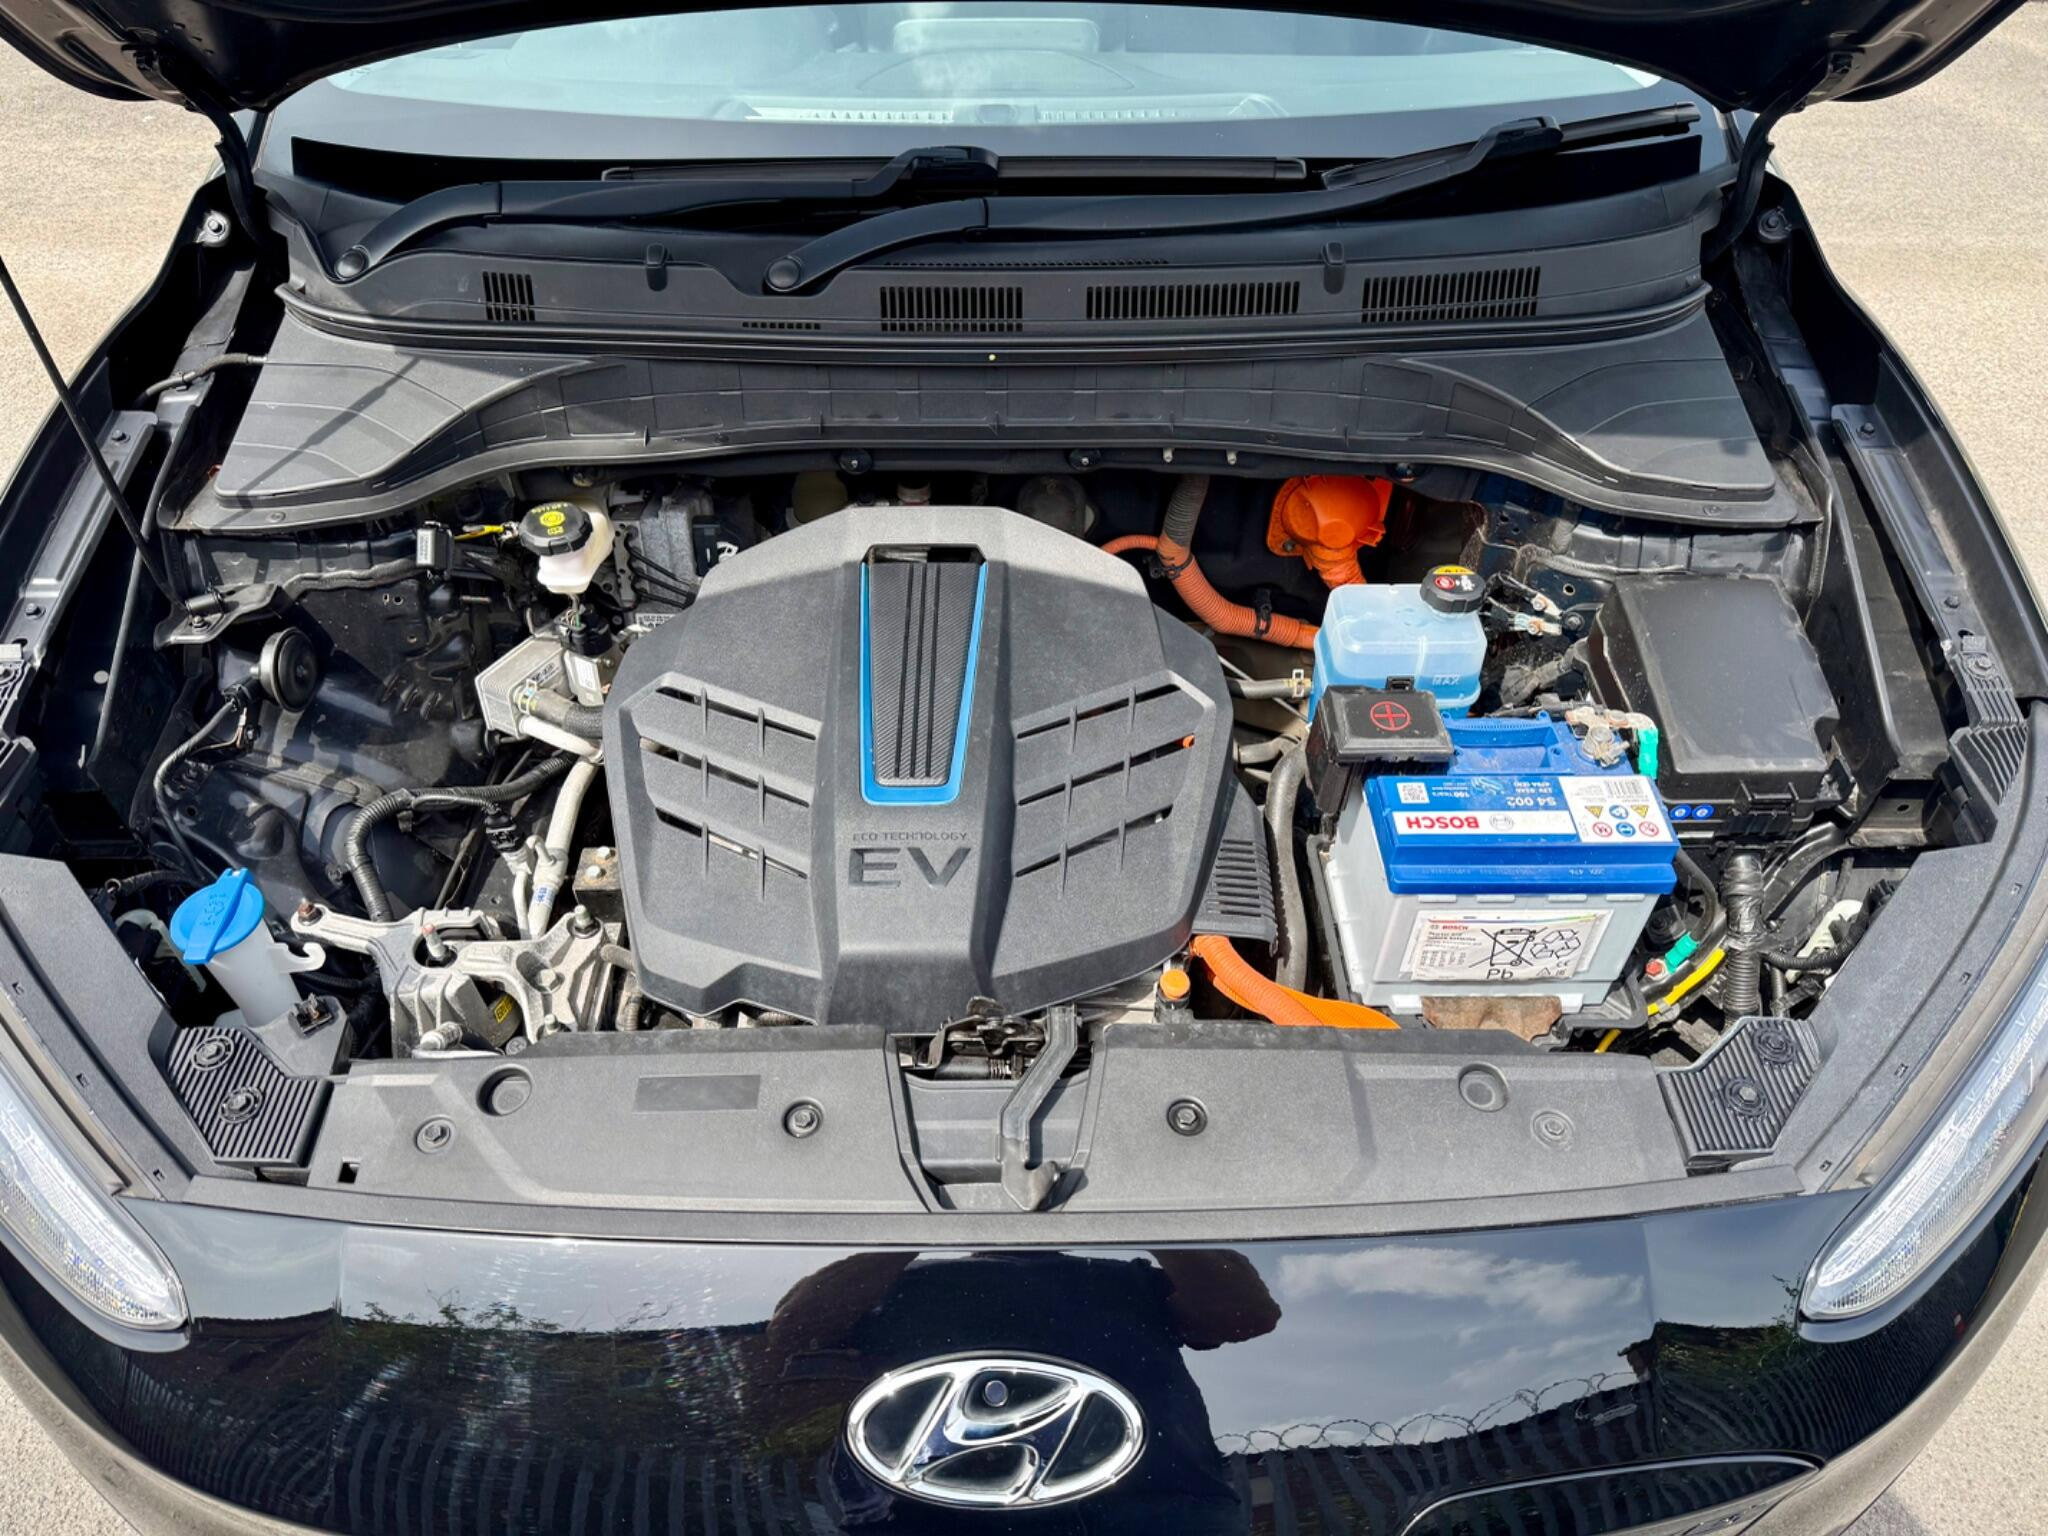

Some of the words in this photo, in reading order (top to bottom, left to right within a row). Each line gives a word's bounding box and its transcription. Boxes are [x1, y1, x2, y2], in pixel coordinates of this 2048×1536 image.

[1432, 673, 1461, 686] MAX
[1537, 796, 1557, 807] S4
[1406, 816, 1479, 829] BOSCH
[853, 831, 879, 841] ECO
[884, 831, 967, 841] TECHNOLOGY
[849, 847, 971, 887] EV
[1487, 968, 1514, 980] Pb
